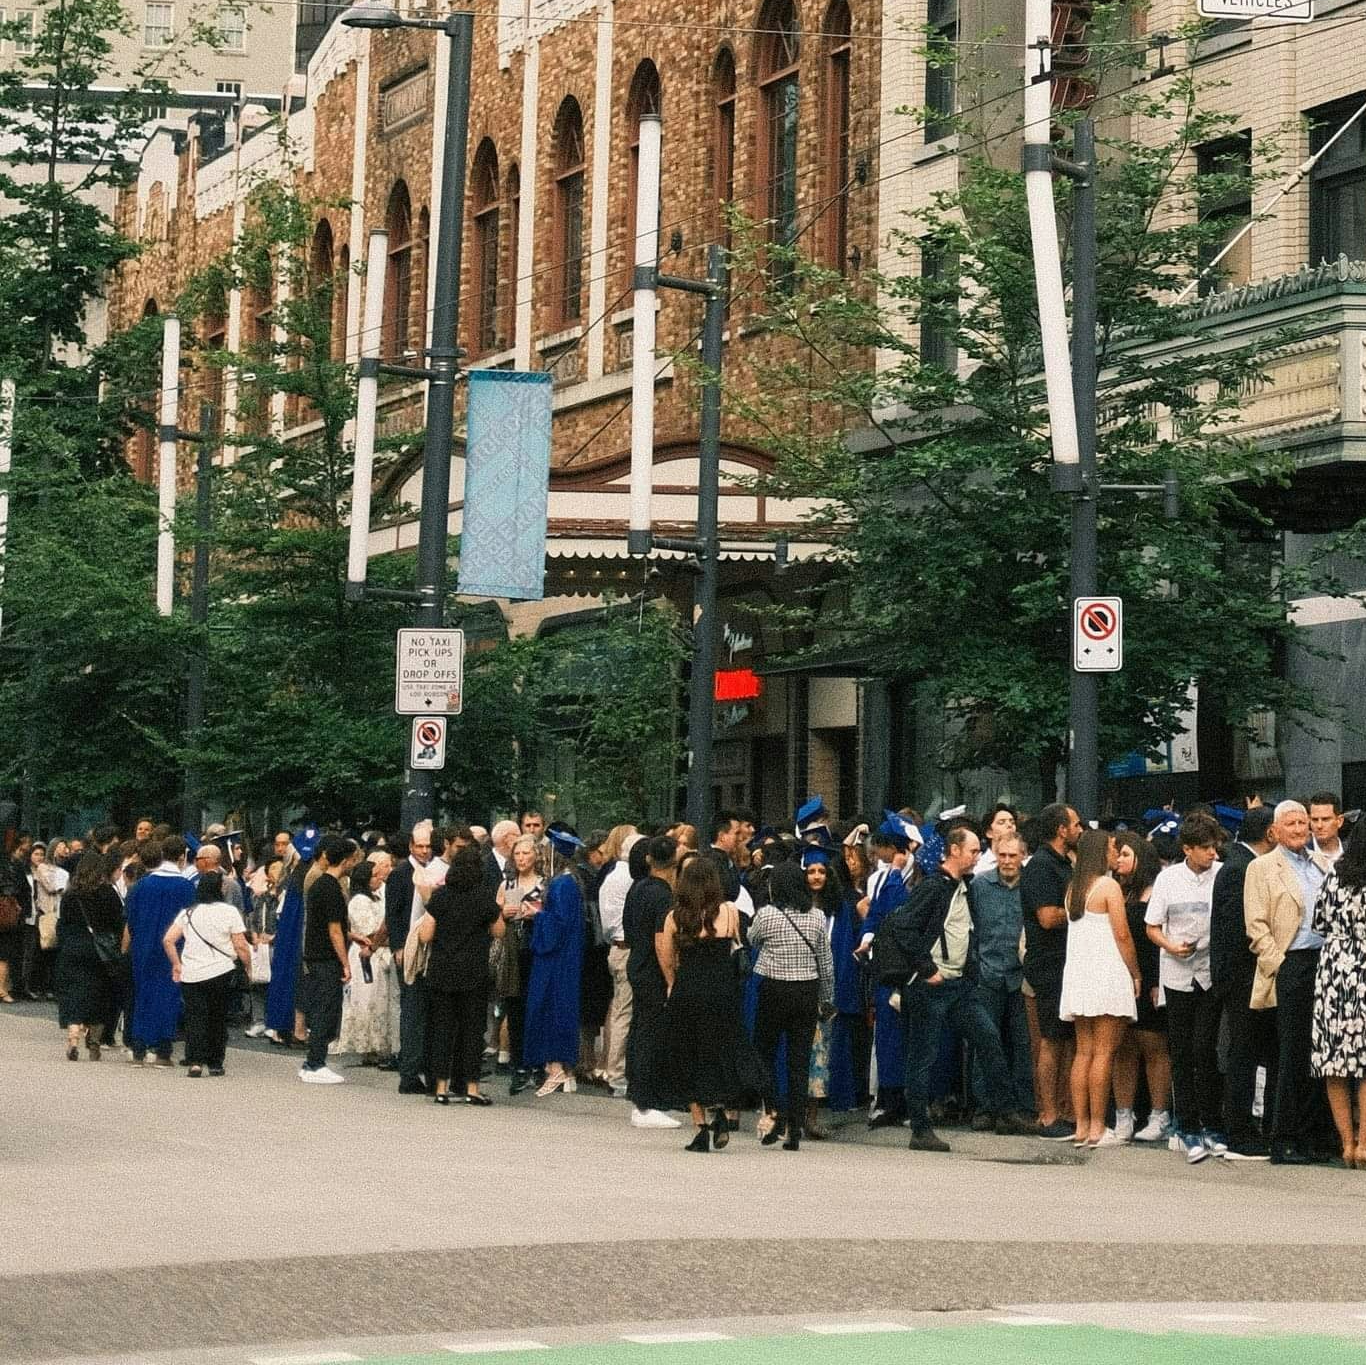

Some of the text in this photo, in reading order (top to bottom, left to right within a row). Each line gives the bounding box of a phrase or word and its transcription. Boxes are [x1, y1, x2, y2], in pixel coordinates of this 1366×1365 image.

[411, 637, 451, 646] NO TAXI
[408, 648, 453, 657] PICK UPS
[423, 659, 437, 668] OR
[403, 670, 457, 679] DROP OFFS
